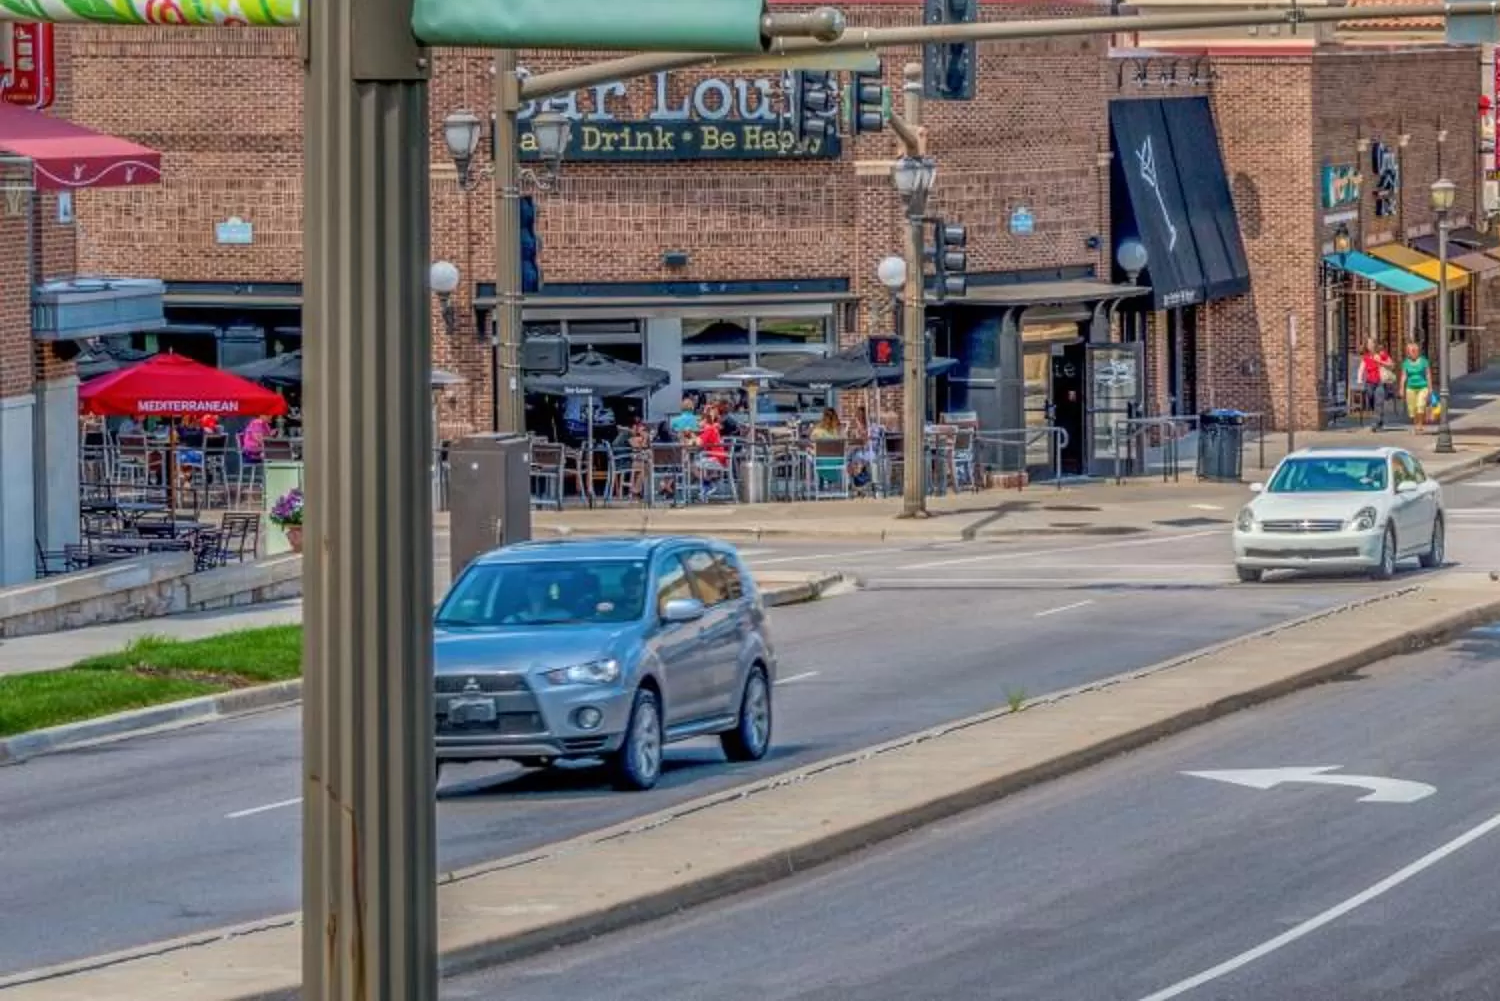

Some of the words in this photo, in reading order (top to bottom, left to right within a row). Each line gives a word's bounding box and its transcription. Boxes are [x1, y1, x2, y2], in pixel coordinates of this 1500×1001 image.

[581, 126, 673, 151] Drink
[700, 126, 736, 149] Be
[742, 126, 821, 155] Hapy
[137, 400, 239, 412] MEDITERRANEAN
